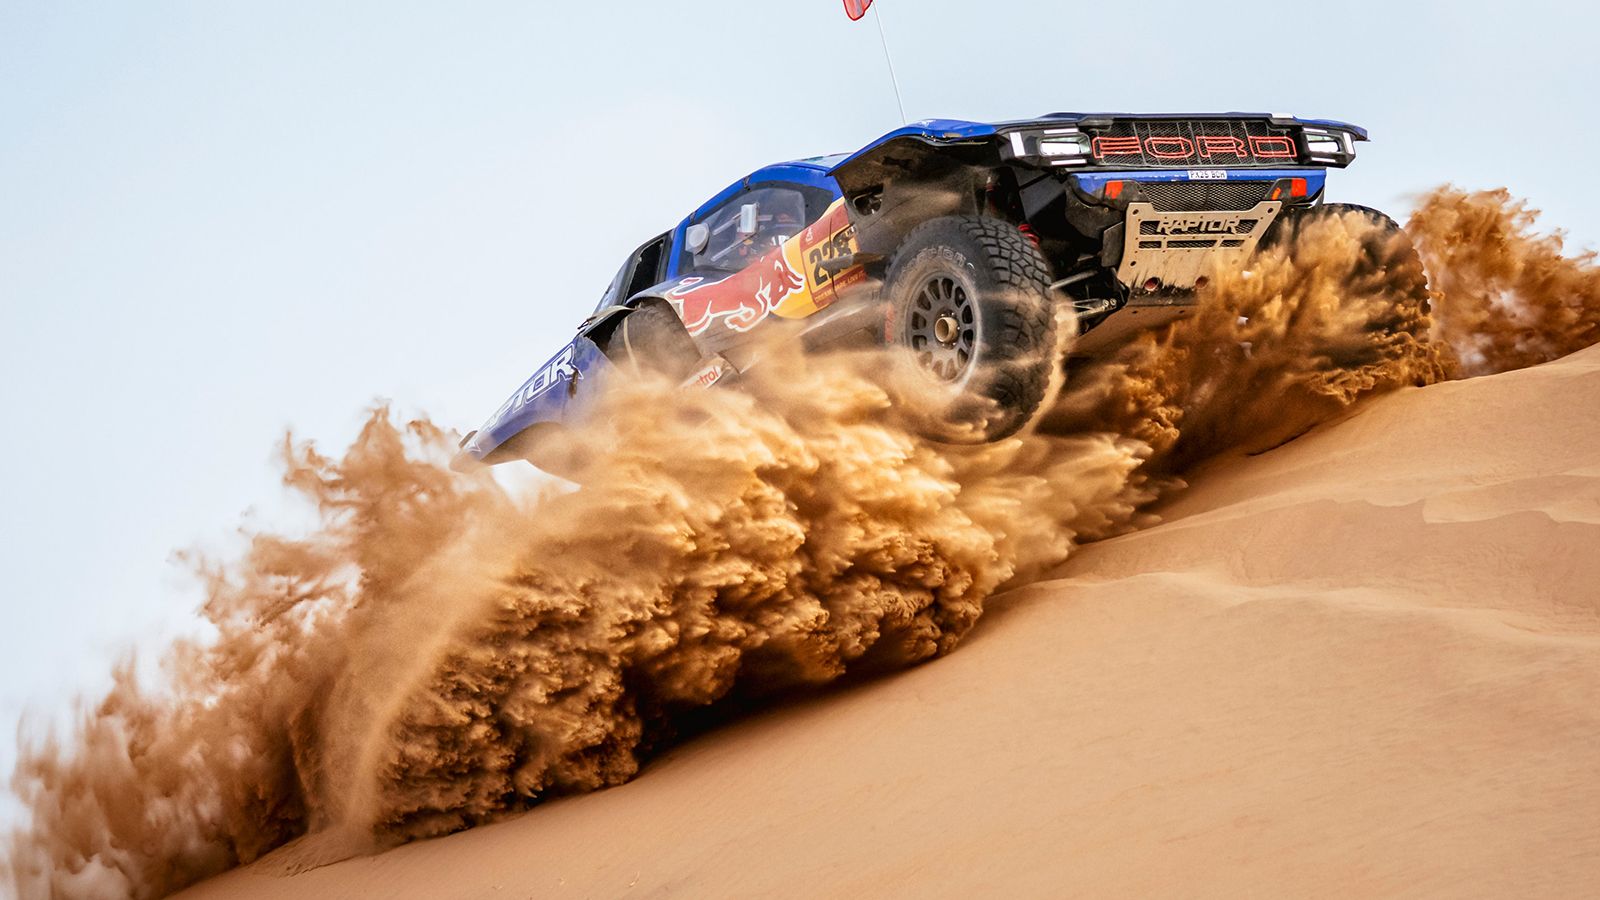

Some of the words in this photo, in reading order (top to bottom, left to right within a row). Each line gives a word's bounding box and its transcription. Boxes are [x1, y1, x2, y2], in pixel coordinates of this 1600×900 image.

[1092, 136, 1298, 158] FORD
[1156, 219, 1240, 235] RAPTOR
[466, 343, 584, 452] PTOR
